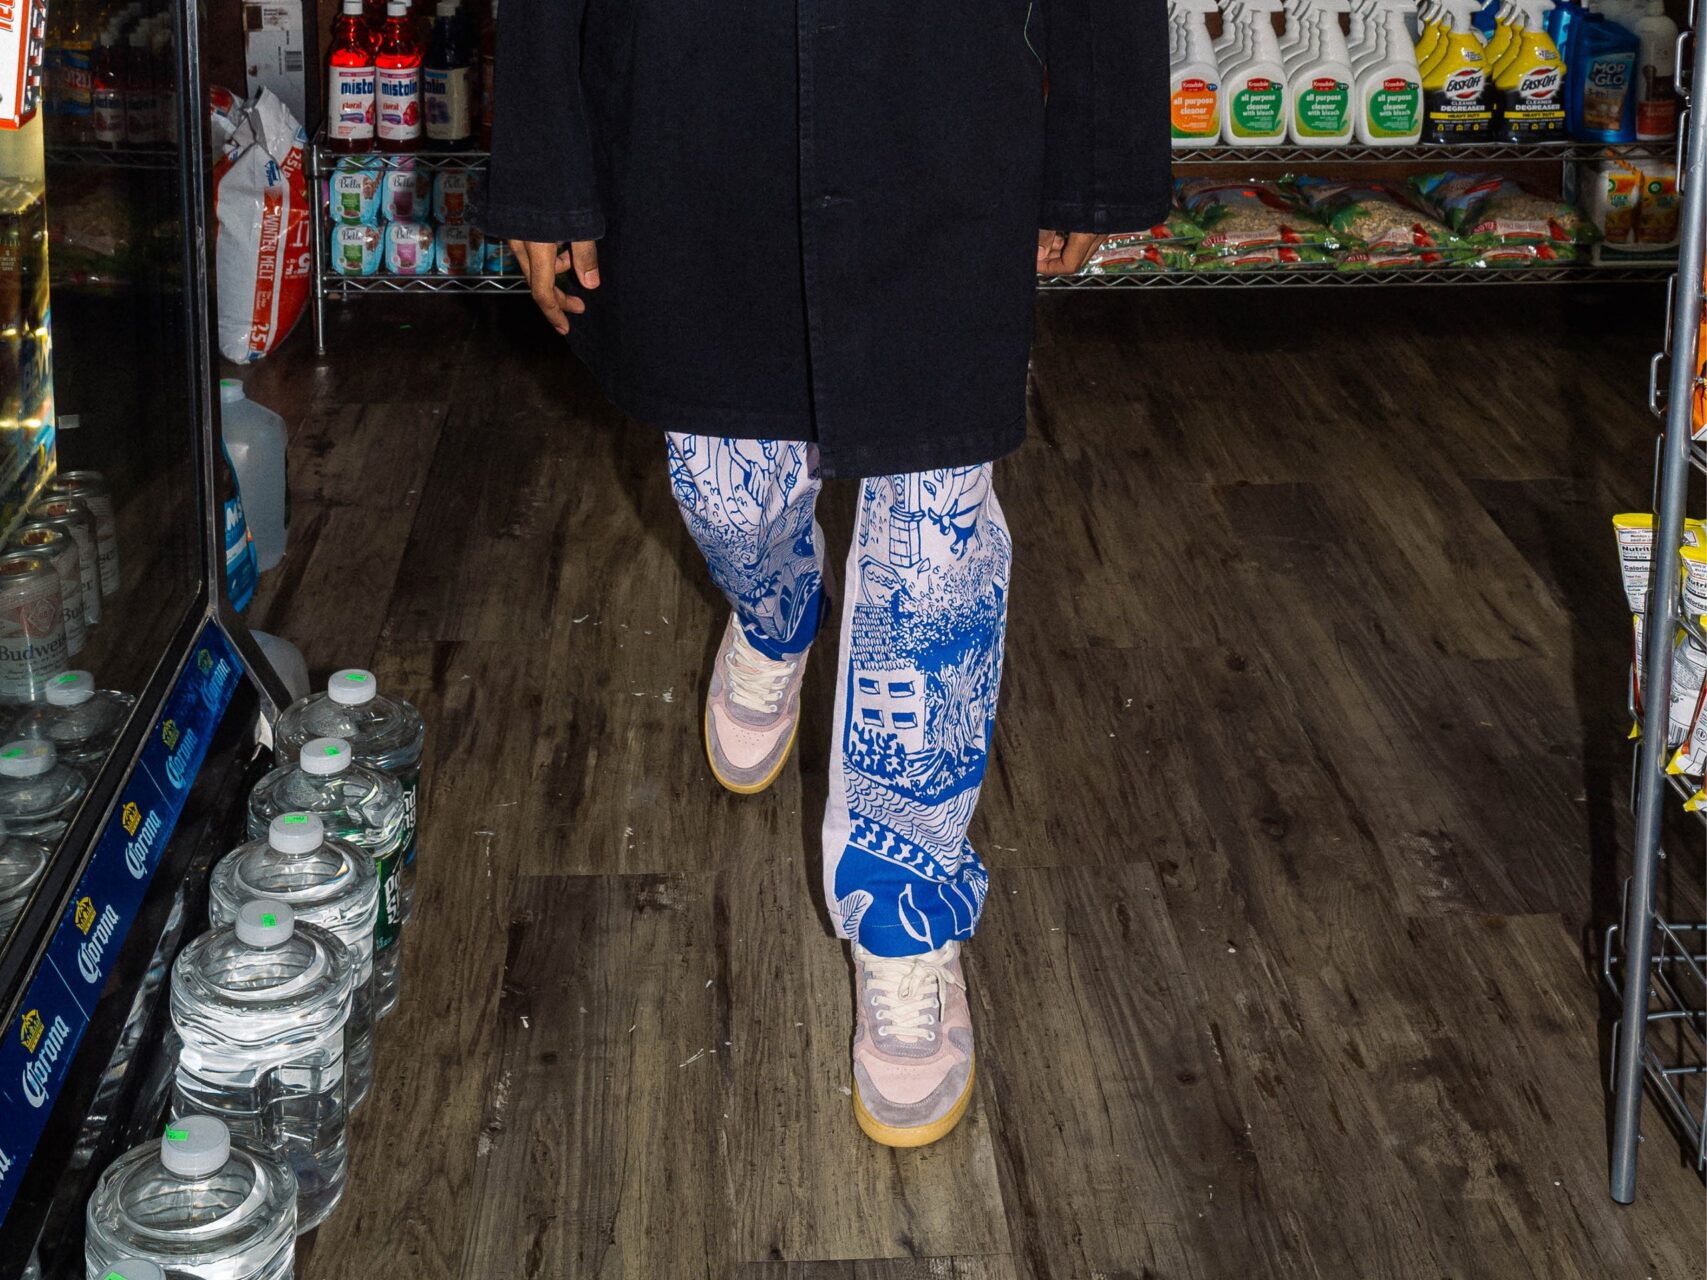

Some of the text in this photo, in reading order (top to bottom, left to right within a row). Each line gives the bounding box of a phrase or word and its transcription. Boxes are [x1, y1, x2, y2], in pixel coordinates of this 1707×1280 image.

[1592, 61, 1626, 75] MOP
[1594, 73, 1626, 87] GLO
[341, 78, 374, 95] misto
[1174, 97, 1183, 105] all
[1251, 94, 1276, 103] purpose
[1316, 94, 1341, 103] purpose
[1387, 94, 1412, 103] purpose
[343, 101, 361, 110] floral
[1246, 103, 1271, 111] cleaner
[1311, 103, 1336, 111] cleaner
[1382, 103, 1407, 111] cleaner
[340, 177, 361, 189] Bella
[393, 175, 415, 187] Bella
[258, 213, 281, 281] WINTER MELT
[200, 657, 232, 714] Corona
[165, 727, 199, 790] Corona
[124, 808, 163, 880] Corona
[77, 903, 120, 985] Corona
[22, 1014, 71, 1109] Corona
